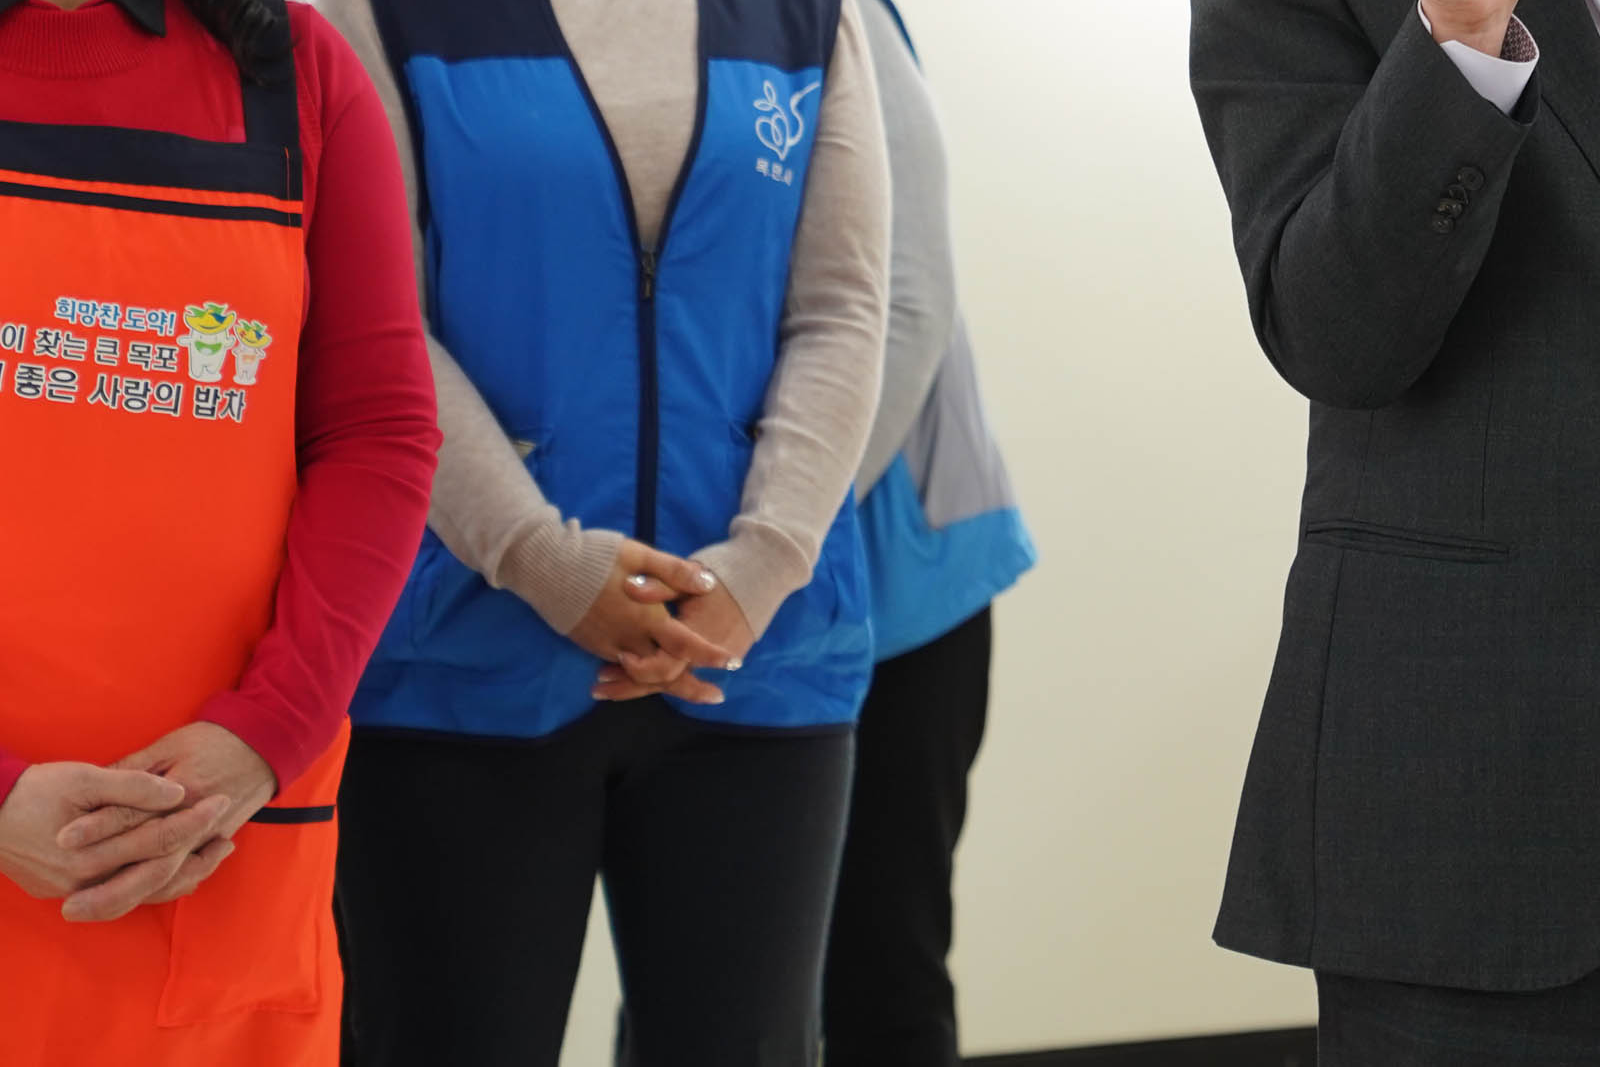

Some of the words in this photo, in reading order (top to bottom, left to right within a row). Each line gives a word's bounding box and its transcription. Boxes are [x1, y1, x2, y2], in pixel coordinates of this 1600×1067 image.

[56, 297, 121, 330] 희망찬
[123, 306, 176, 335] 도약!
[33, 327, 88, 362] 찾는
[94, 335, 121, 366] 큰
[127, 341, 179, 372] 목포
[15, 363, 78, 403] 좋은
[87, 372, 183, 416] 사랑의
[193, 385, 246, 423] 밥차
